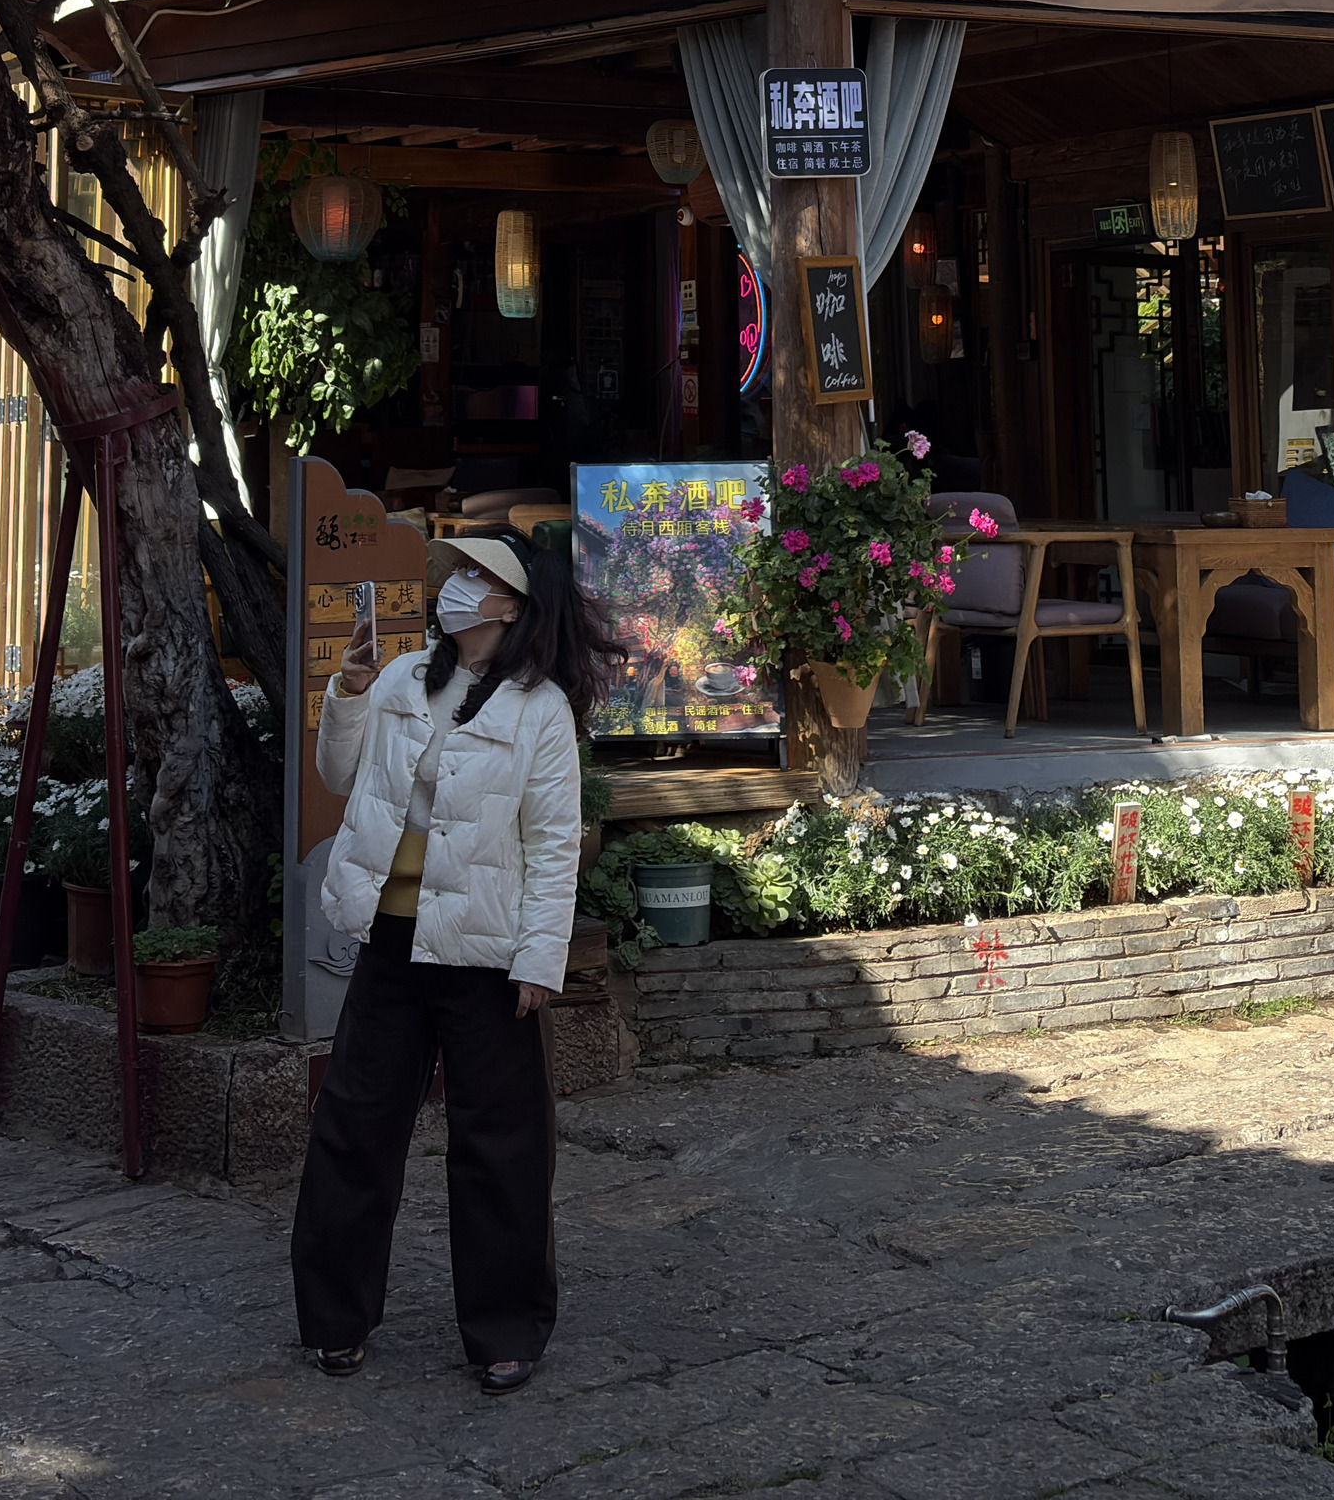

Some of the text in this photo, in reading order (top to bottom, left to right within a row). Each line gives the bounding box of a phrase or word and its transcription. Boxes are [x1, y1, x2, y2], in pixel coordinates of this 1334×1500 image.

[769, 80, 865, 130] 私奔酒吧
[775, 140, 862, 154] 咖啡 调酒 下午茶
[776, 157, 864, 170] 住宿 简餐 威士忌
[816, 286, 848, 370] 咖啡
[599, 478, 747, 513] 私奔酒吧
[621, 520, 730, 537] 待月西厢客栈
[645, 706, 667, 717] 咖啡
[684, 704, 730, 717] 民谣酒馆
[742, 704, 764, 716] 住宿
[644, 719, 717, 732] 鸡尾酒 简餐
